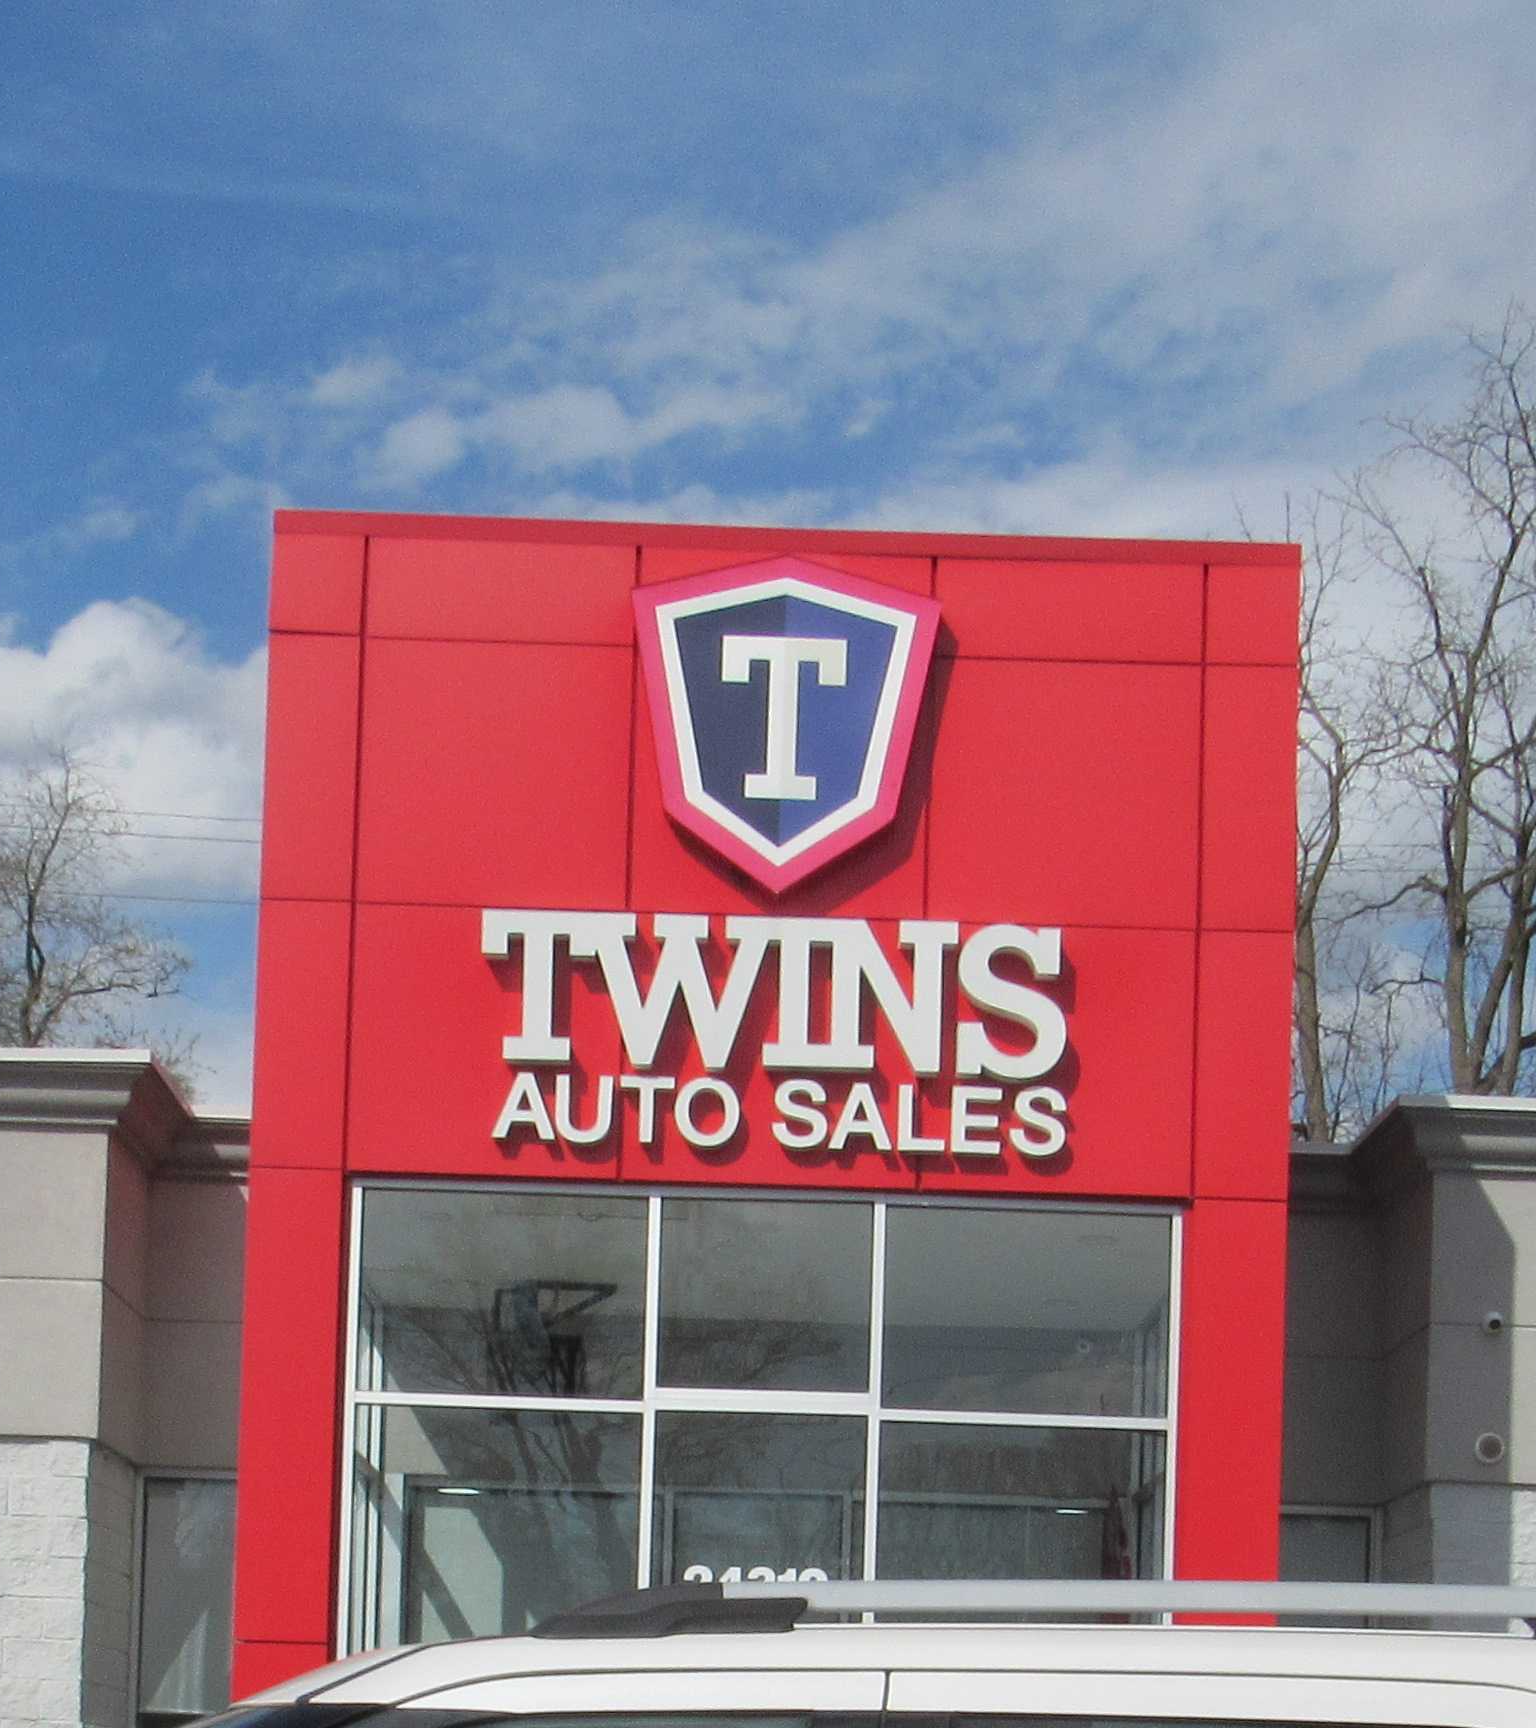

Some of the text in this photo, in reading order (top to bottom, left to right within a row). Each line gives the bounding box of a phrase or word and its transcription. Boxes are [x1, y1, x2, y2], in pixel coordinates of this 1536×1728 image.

[721, 635, 848, 801] T
[480, 909, 1068, 1082] TWINS
[491, 1071, 1068, 1158] AUTO SALES
